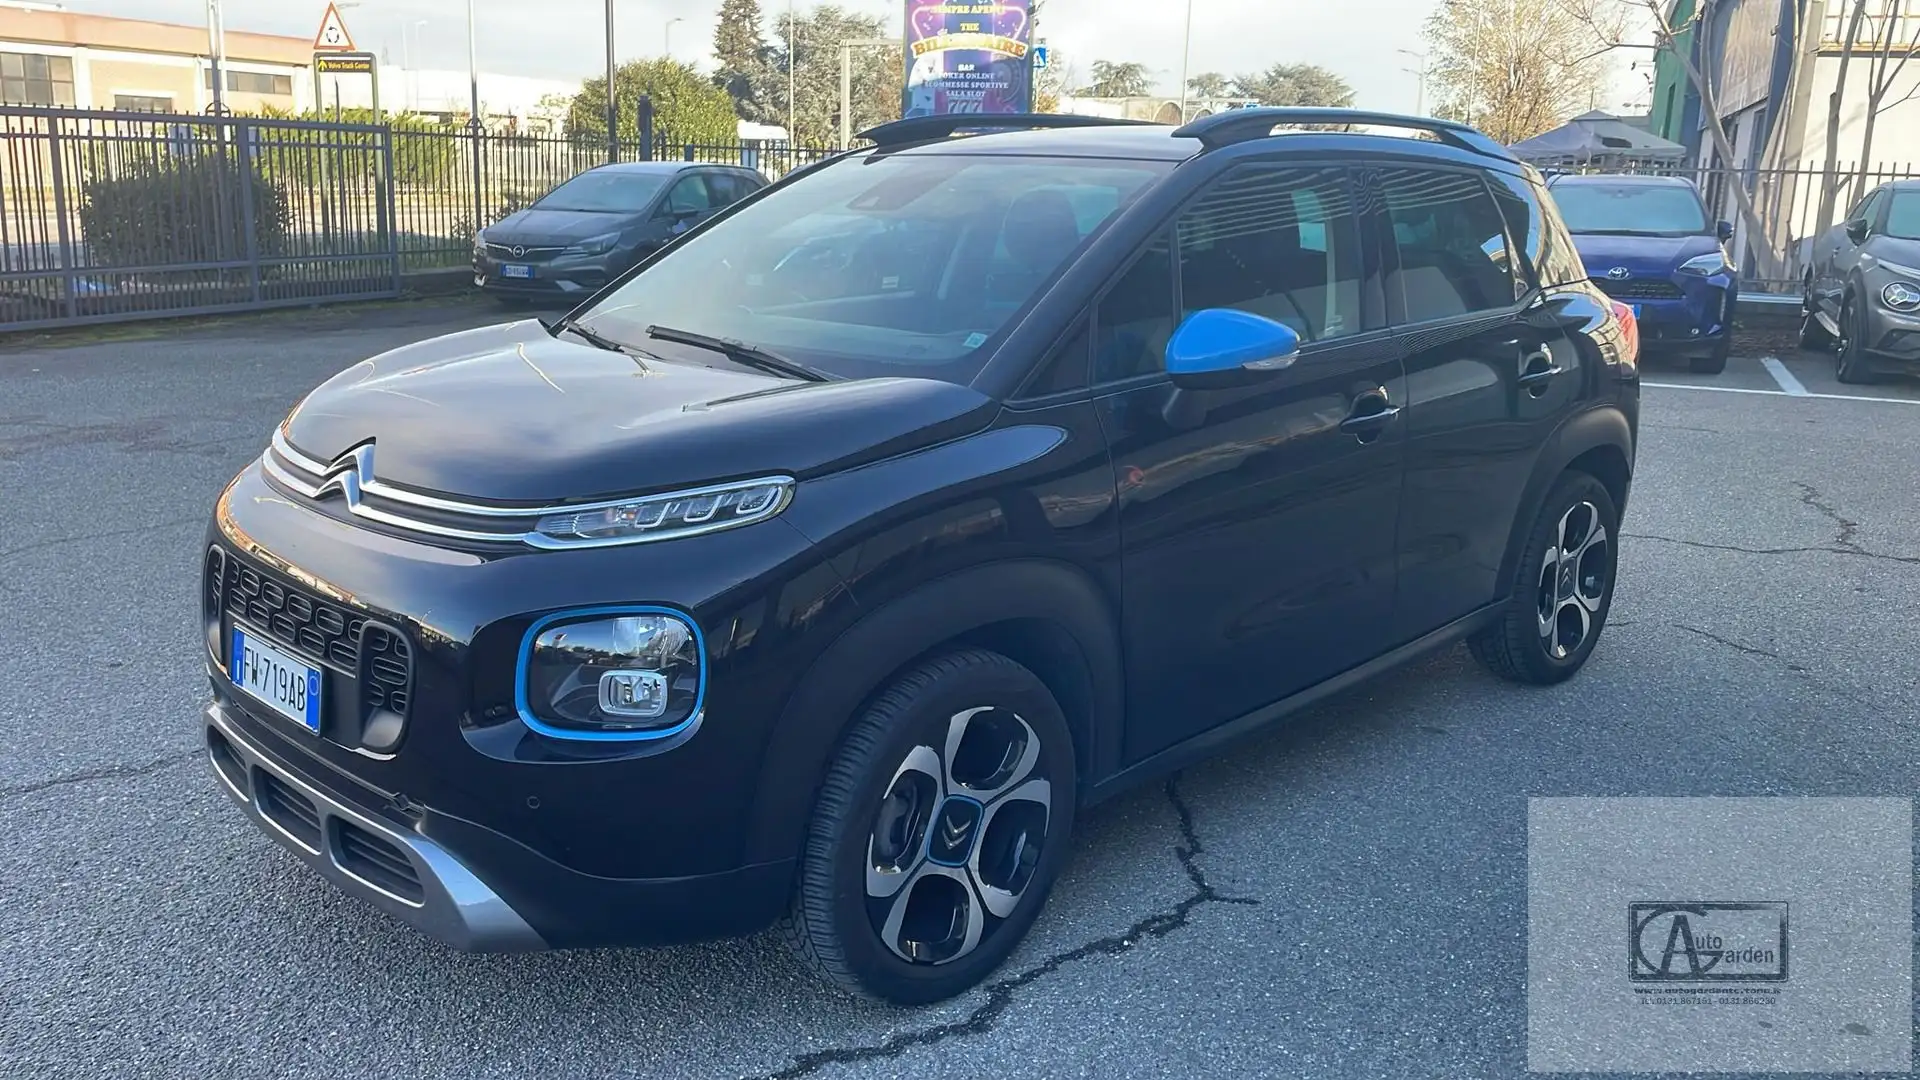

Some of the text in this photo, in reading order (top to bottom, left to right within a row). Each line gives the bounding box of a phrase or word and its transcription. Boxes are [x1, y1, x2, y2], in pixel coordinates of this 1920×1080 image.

[960, 22, 979, 31] THE
[912, 34, 1027, 57] BILAIRE
[939, 72, 995, 80] OKER ONLINE
[970, 81, 1009, 89] SPORTIVE
[263, 657, 306, 712] 719AB
